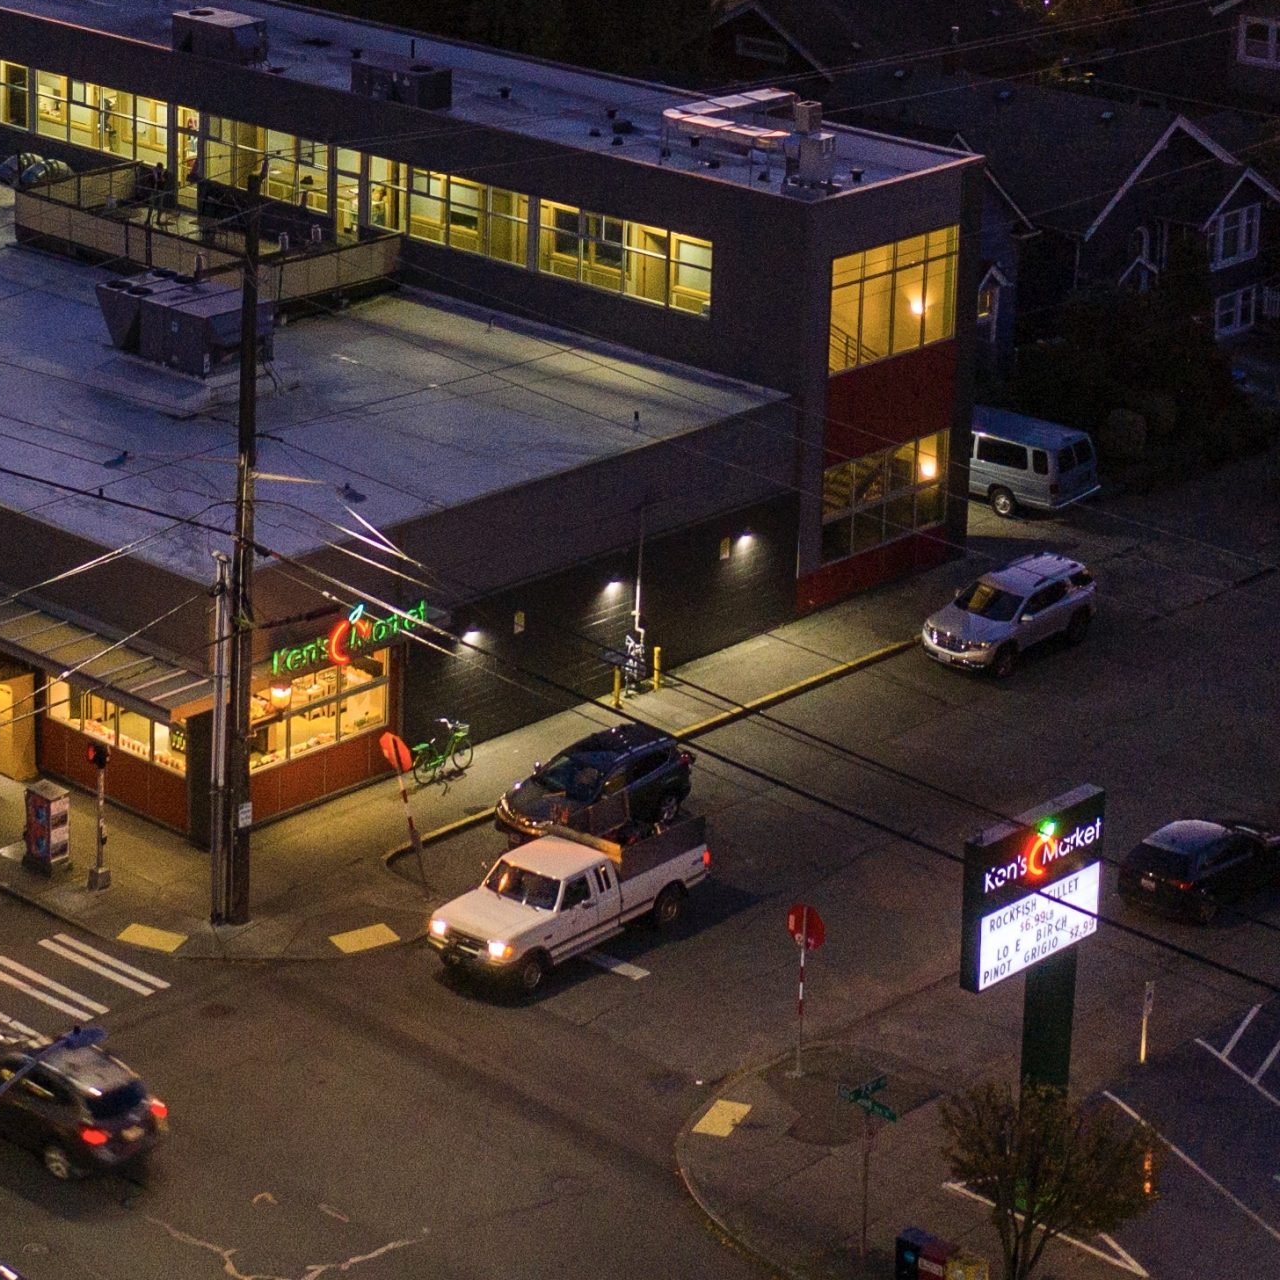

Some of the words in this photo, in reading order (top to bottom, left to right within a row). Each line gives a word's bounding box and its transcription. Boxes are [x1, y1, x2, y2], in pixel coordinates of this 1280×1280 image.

[984, 855, 1028, 893] Ken's
[1042, 817, 1101, 865] Market
[989, 897, 1037, 933] ROCKFISH
[1036, 915, 1067, 942] BIRCH
[983, 959, 1012, 984] PINOT
[1024, 937, 1059, 963] GRIGIO
